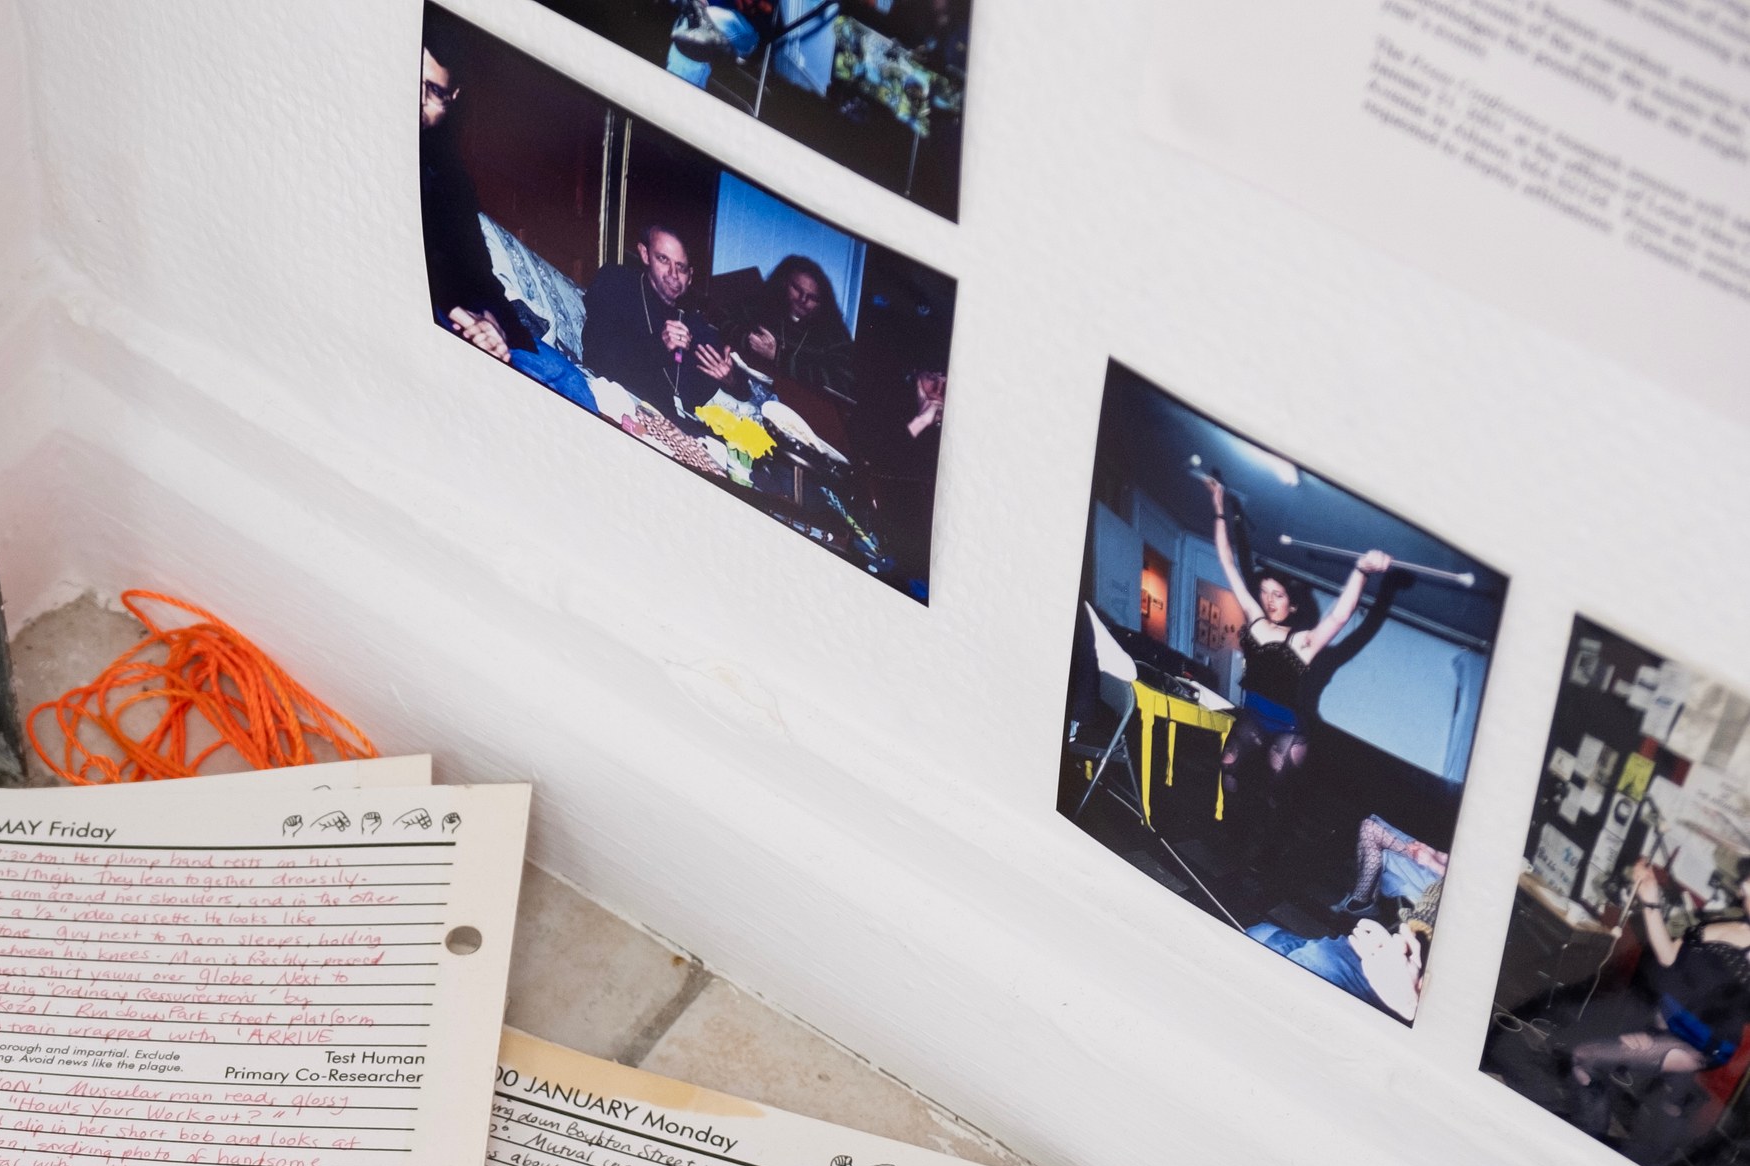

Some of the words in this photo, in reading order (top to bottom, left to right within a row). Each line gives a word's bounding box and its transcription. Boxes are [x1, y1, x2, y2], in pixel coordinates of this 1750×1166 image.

[49, 821, 116, 842] Friday
[46, 1044, 70, 1055] and
[73, 1045, 129, 1062] impartial.
[135, 1050, 181, 1061] Exclude
[325, 1051, 356, 1065] Test
[361, 1051, 425, 1065] Human
[19, 1053, 54, 1065] Avoid
[58, 1057, 88, 1067] news
[92, 1058, 113, 1069] like
[117, 1060, 135, 1070] the
[138, 1062, 184, 1074] plague.
[225, 1066, 289, 1084] Primary
[295, 1067, 424, 1083] Co-Researcher
[523, 1076, 638, 1121] JANUARY
[642, 1110, 739, 1152] Monday
